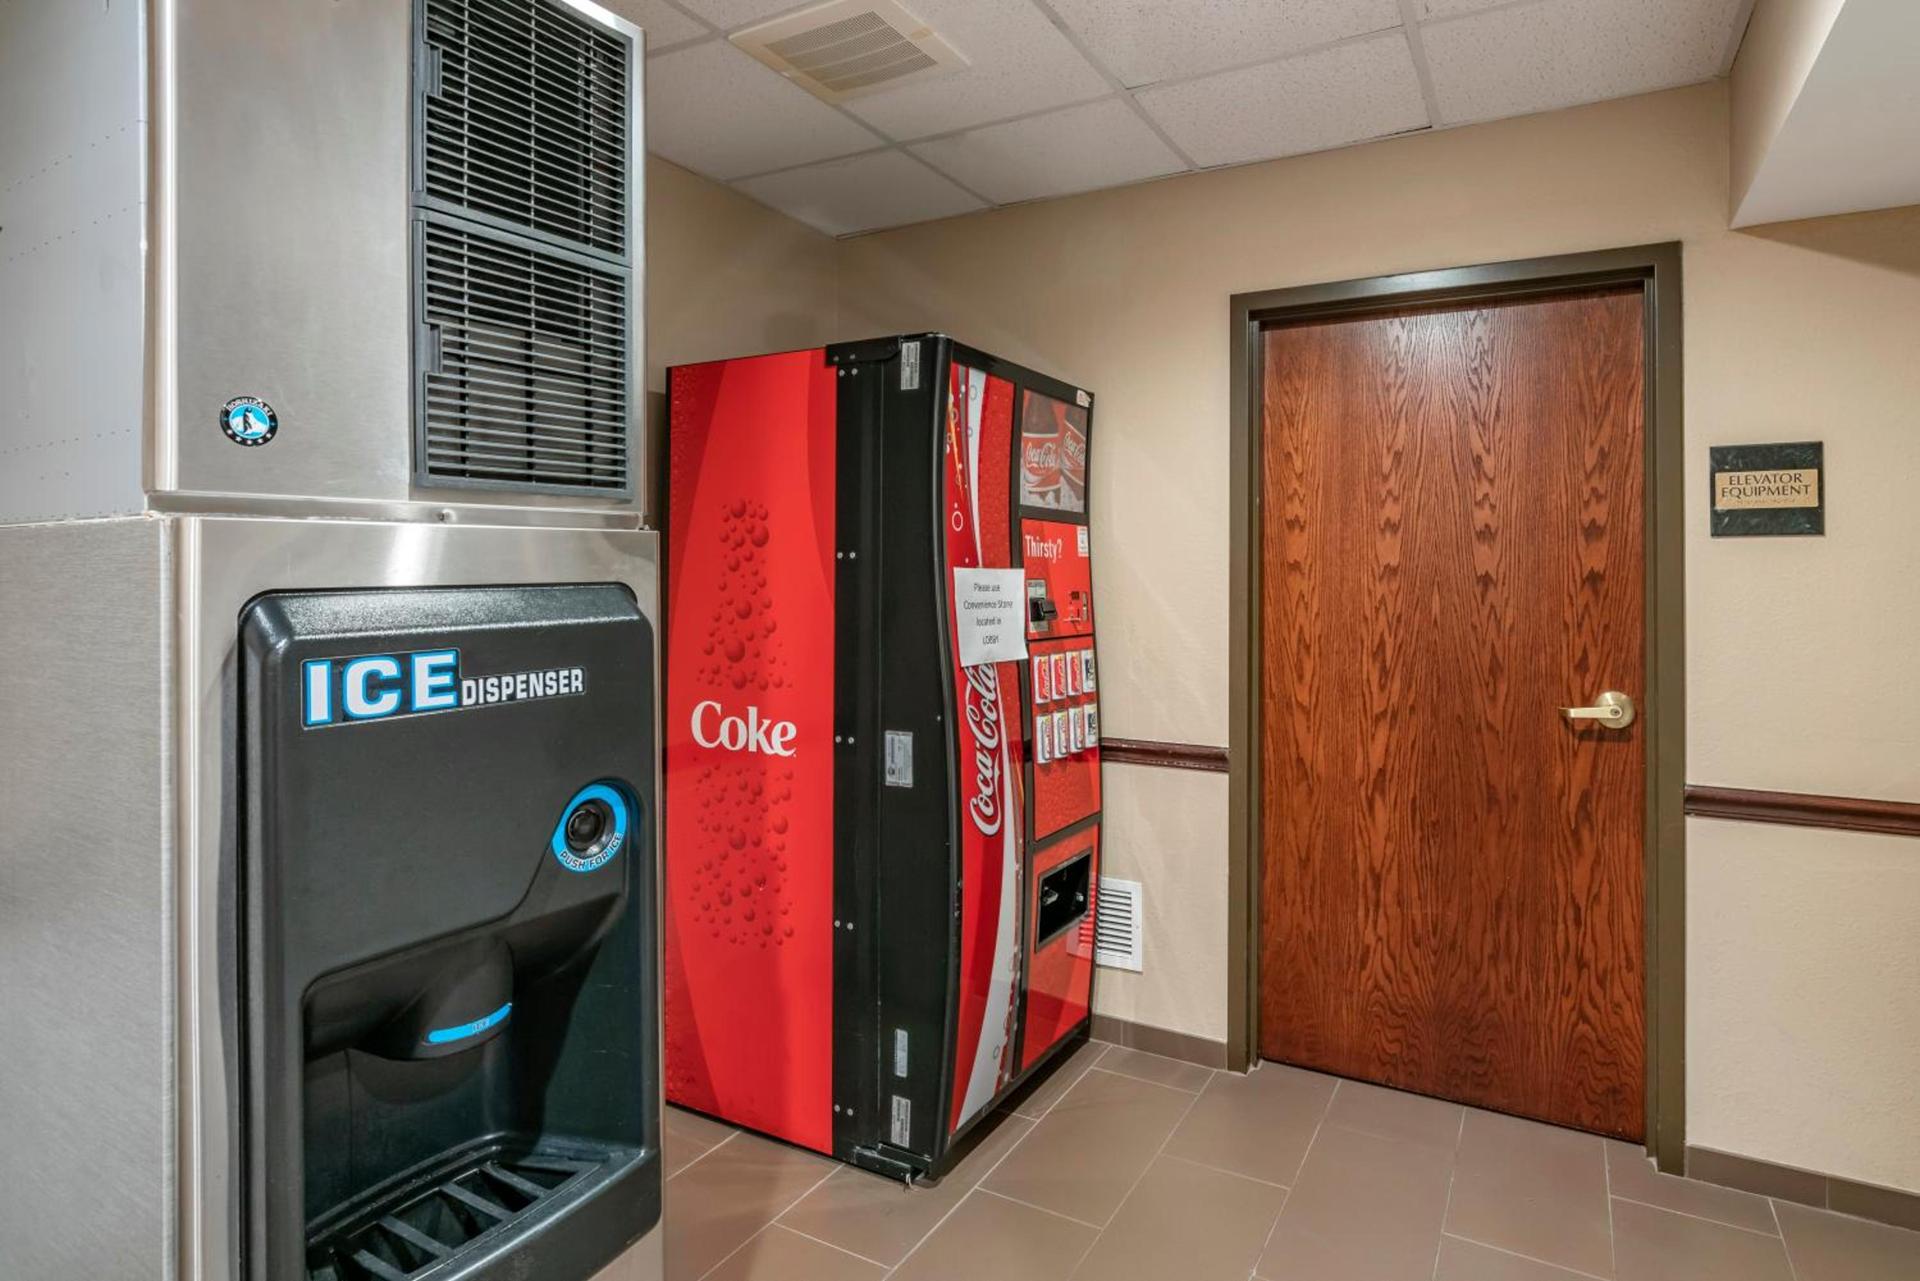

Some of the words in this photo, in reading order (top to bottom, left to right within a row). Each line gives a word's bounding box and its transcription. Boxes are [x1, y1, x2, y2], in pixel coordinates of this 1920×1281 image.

[1729, 472, 1803, 486] ELEVATOR
[1721, 484, 1811, 499] EQUIPMENT
[1024, 535, 1063, 564] Thirsty?
[974, 583, 990, 592] Please
[991, 584, 1000, 592] use
[963, 600, 996, 610] Convenience
[976, 616, 995, 627] located
[306, 650, 458, 726] ICE
[462, 668, 585, 706] DISPENSER
[691, 700, 797, 757] Coke
[964, 662, 1001, 836] Coca-Cola
[560, 851, 585, 869] PUSH
[588, 852, 609, 868] FOR
[610, 833, 624, 851] ICE
